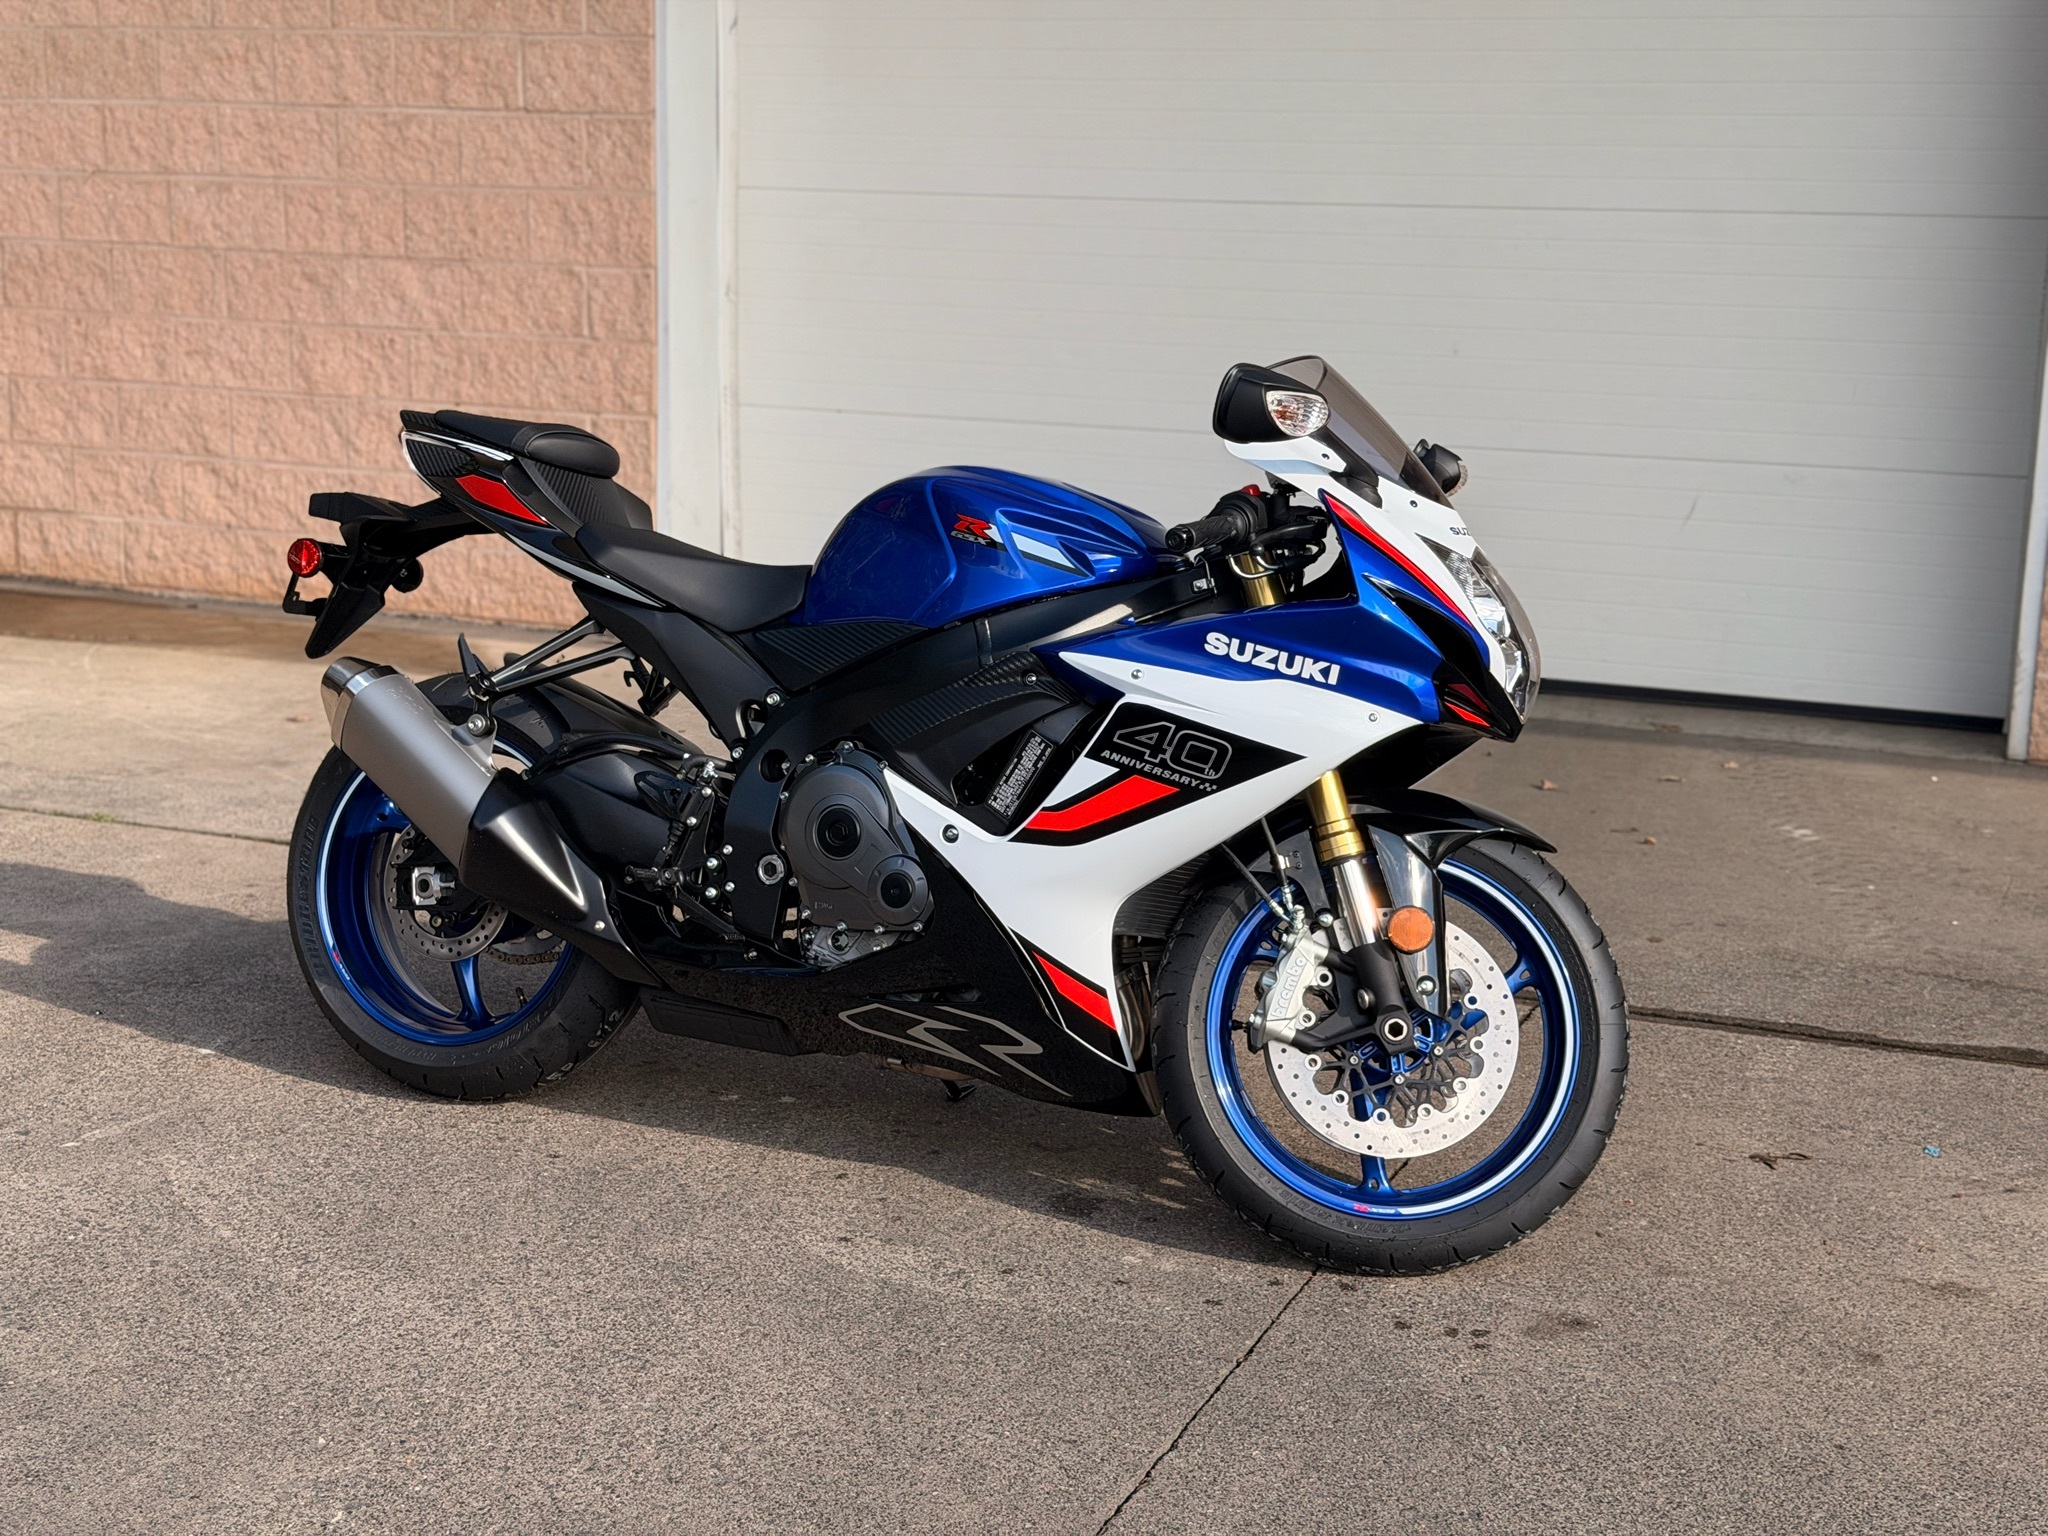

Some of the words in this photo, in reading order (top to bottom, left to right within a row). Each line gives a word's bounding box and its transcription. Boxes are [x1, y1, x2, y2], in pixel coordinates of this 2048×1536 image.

[950, 530, 992, 546] GSX
[1204, 632, 1340, 685] SUZUKI
[1100, 749, 1201, 787] ANNIVERSARY
[1270, 956, 1308, 1018] brembo
